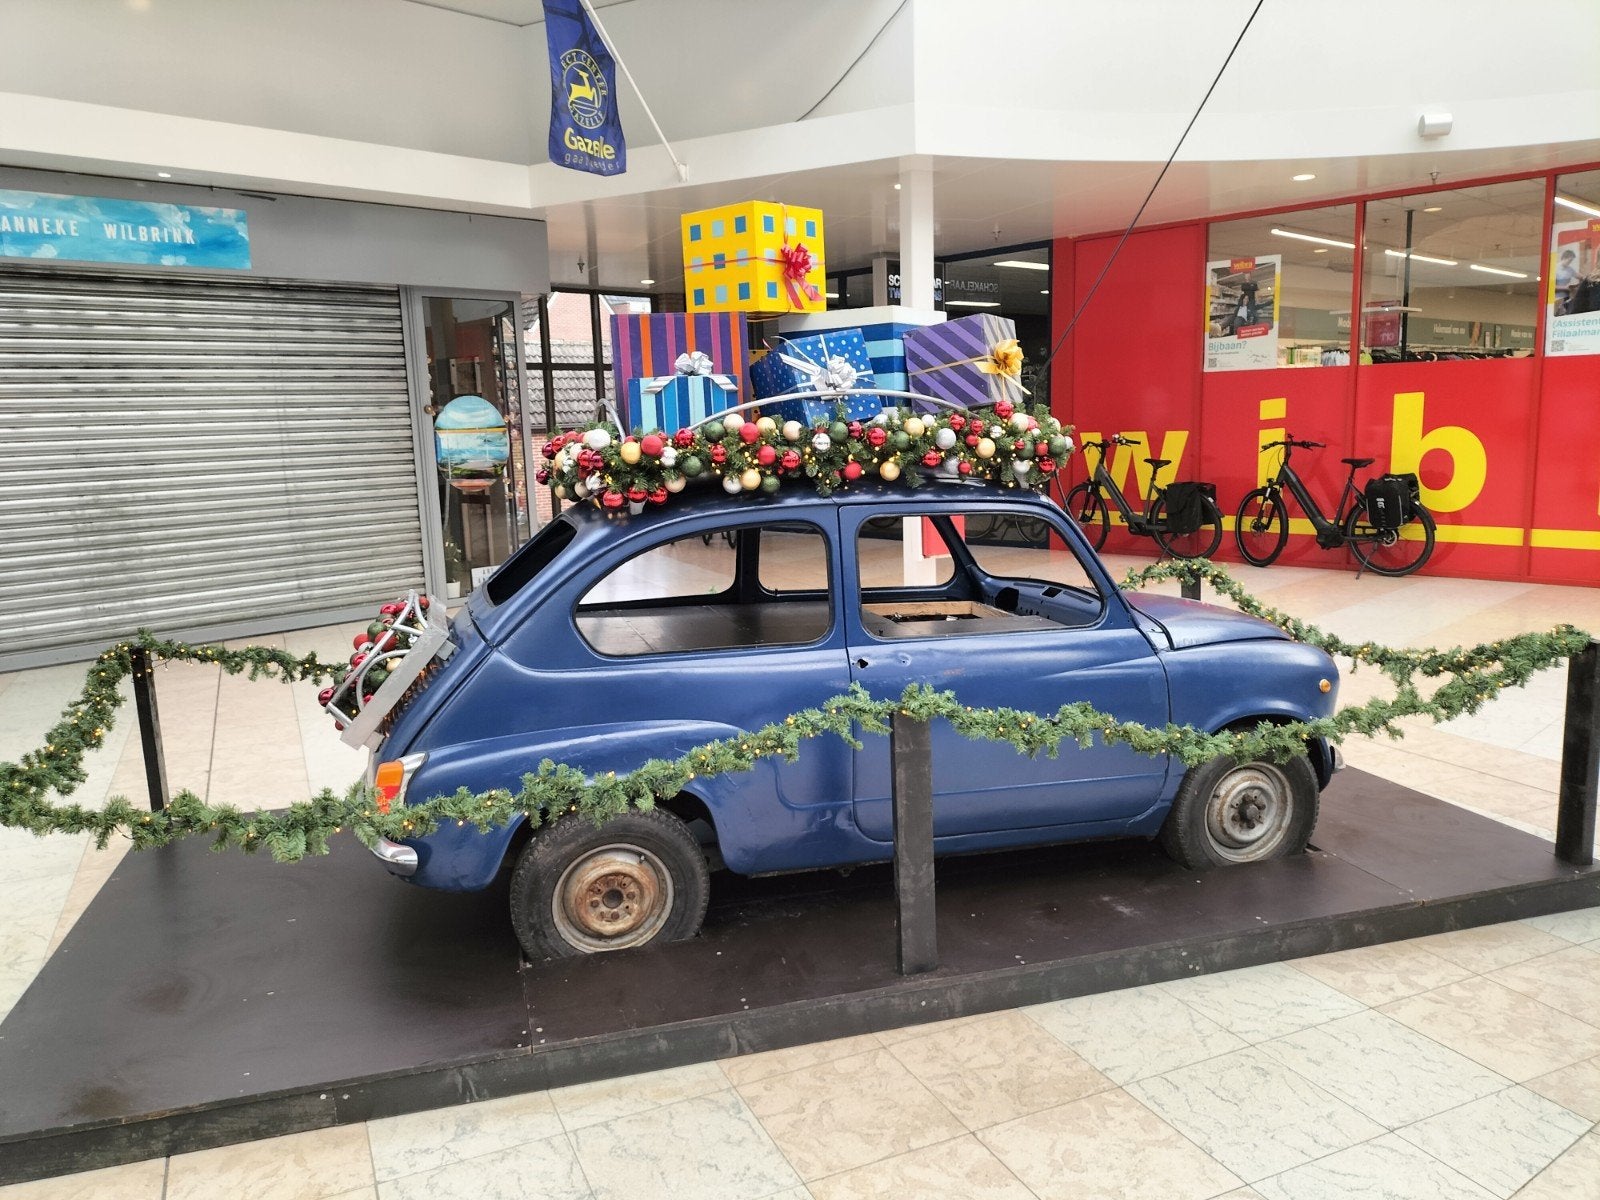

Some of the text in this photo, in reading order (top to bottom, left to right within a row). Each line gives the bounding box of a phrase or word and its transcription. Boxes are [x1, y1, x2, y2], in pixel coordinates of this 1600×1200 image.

[1, 215, 196, 245] ANNEKE WILBRINK
[1208, 340, 1248, 353] Bijbaan?
[1080, 392, 1600, 515] wib
